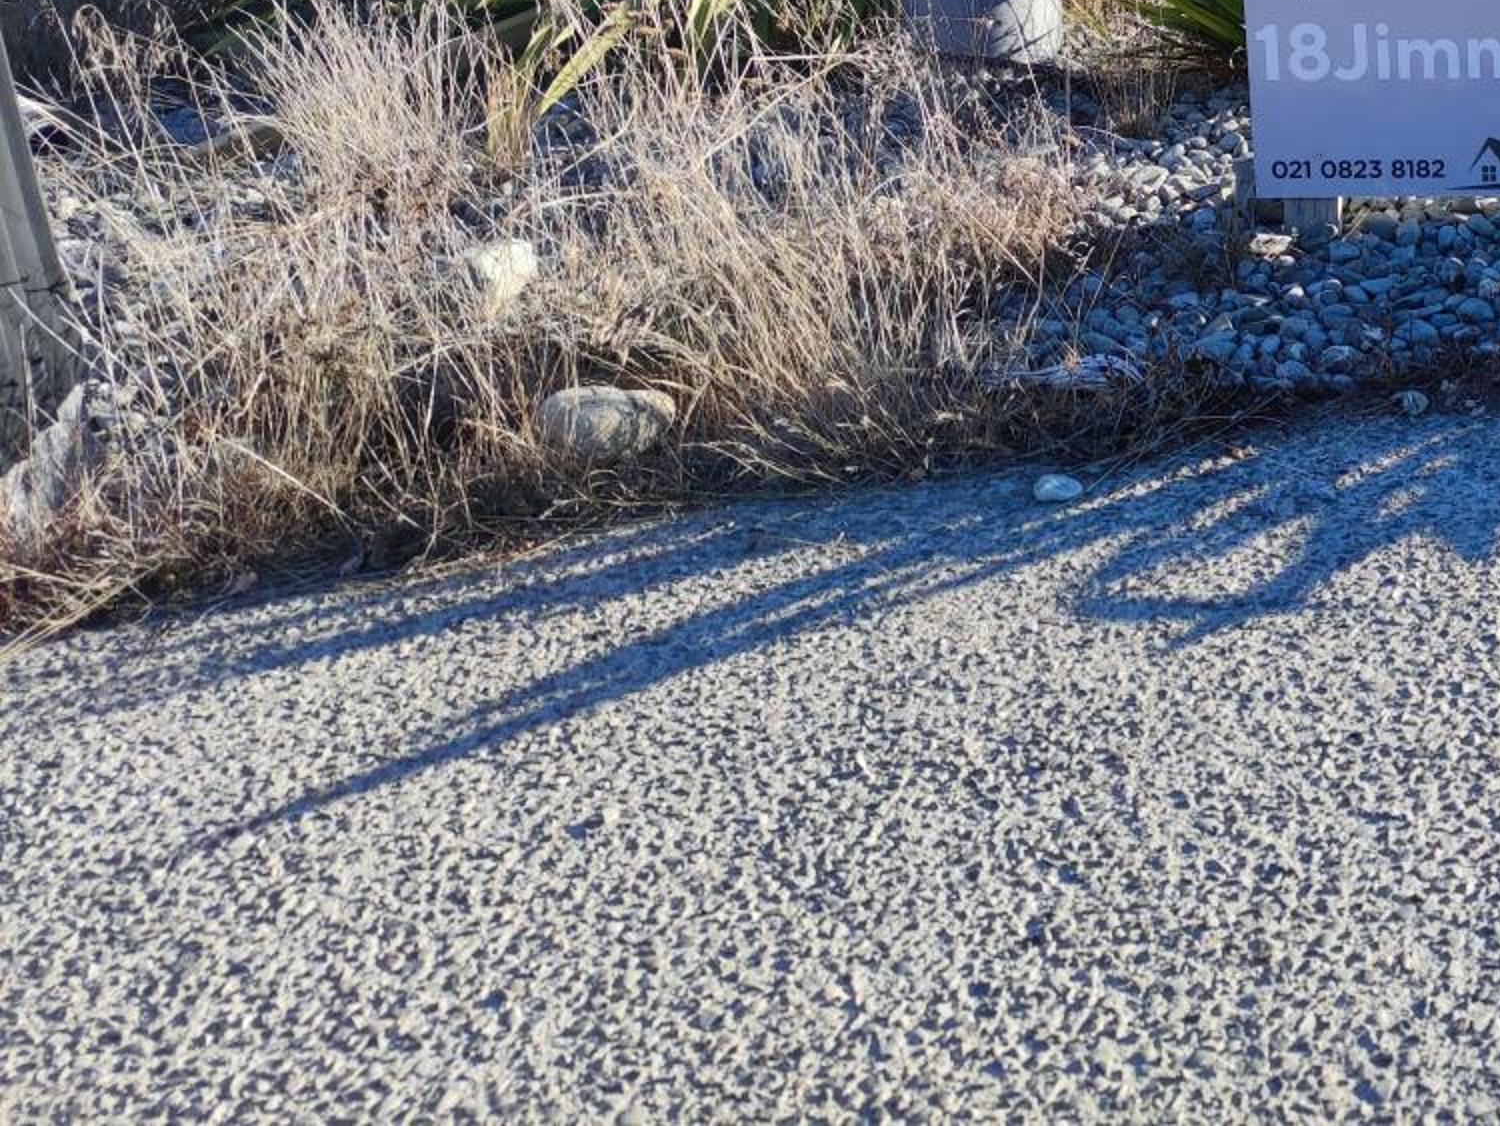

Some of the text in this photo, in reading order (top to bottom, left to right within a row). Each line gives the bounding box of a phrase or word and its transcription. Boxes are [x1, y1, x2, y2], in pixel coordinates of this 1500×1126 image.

[1272, 159, 1446, 179] 021 0823 8182
